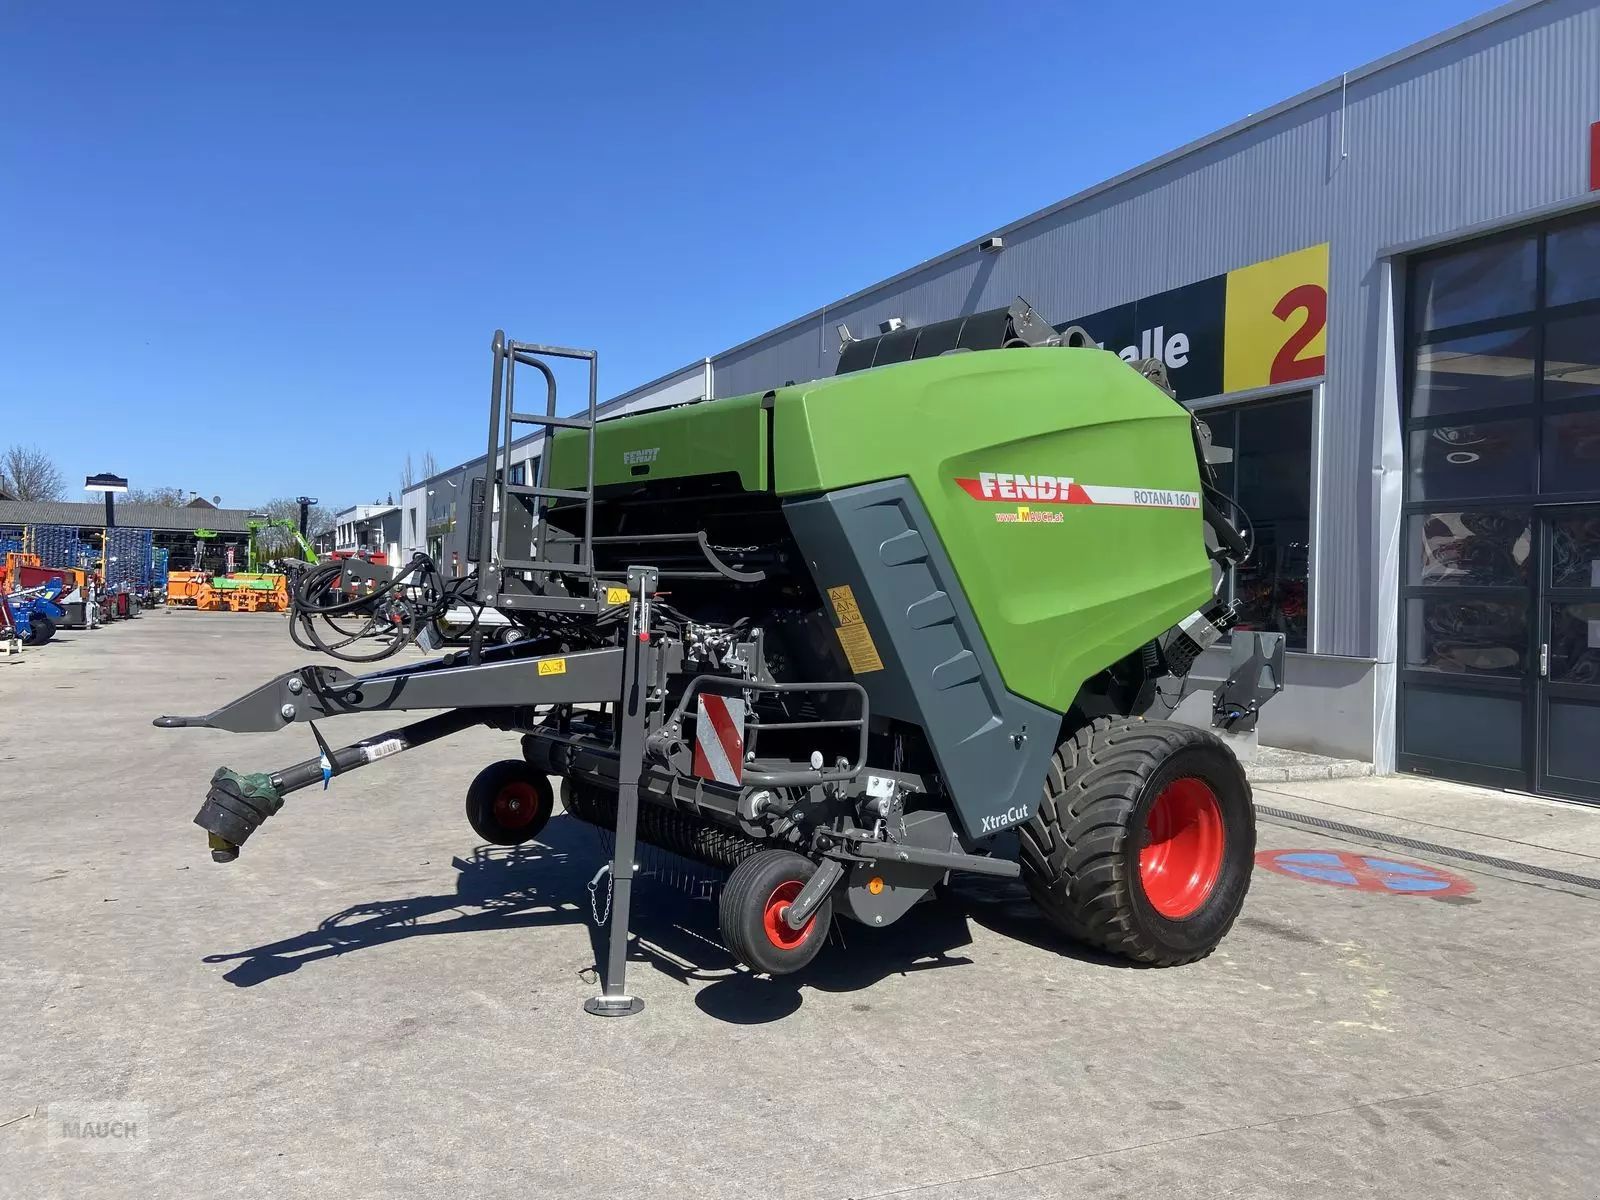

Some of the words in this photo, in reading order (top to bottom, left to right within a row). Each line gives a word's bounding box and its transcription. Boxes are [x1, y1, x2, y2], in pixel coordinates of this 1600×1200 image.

[1269, 284, 1327, 385] 2
[623, 447, 660, 465] FENDT
[979, 472, 1074, 501] FENDT
[1134, 490, 1173, 505] ROTANA
[1174, 493, 1191, 506] 160
[981, 804, 1029, 833] XtraCut
